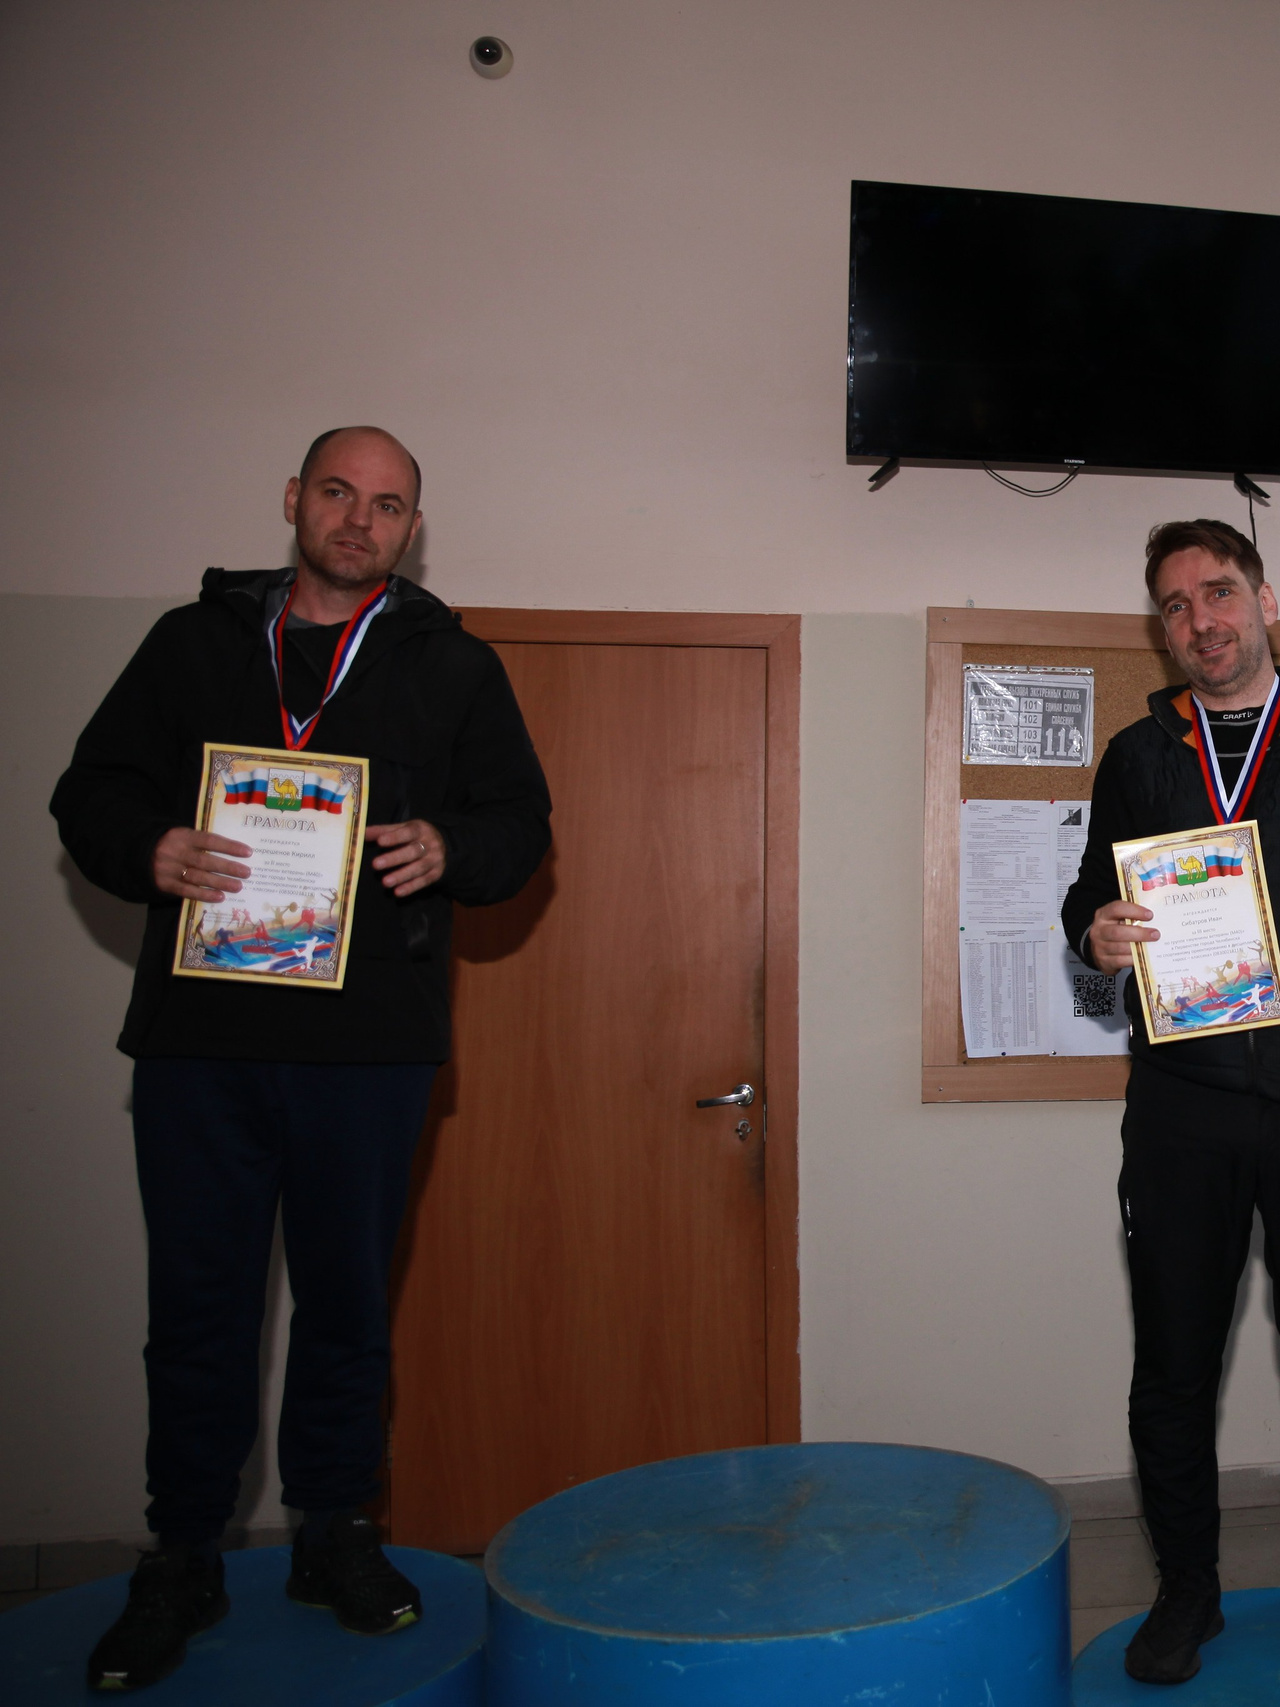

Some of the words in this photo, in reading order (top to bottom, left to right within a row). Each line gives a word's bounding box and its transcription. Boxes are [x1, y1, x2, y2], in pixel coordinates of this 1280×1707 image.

[1063, 689, 1080, 699] СЛУЖБ
[1024, 700, 1038, 710] 101
[1024, 715, 1038, 724] 102
[1222, 712, 1247, 720] CRAFT
[1023, 730, 1038, 739] 103
[1043, 727, 1081, 757] 112
[1022, 745, 1037, 754] 104
[243, 814, 317, 832] ГРАМОТА
[291, 850, 316, 859] Кирилл
[1164, 886, 1228, 906] ГРАМОТА
[1181, 917, 1207, 927] Сибатров
